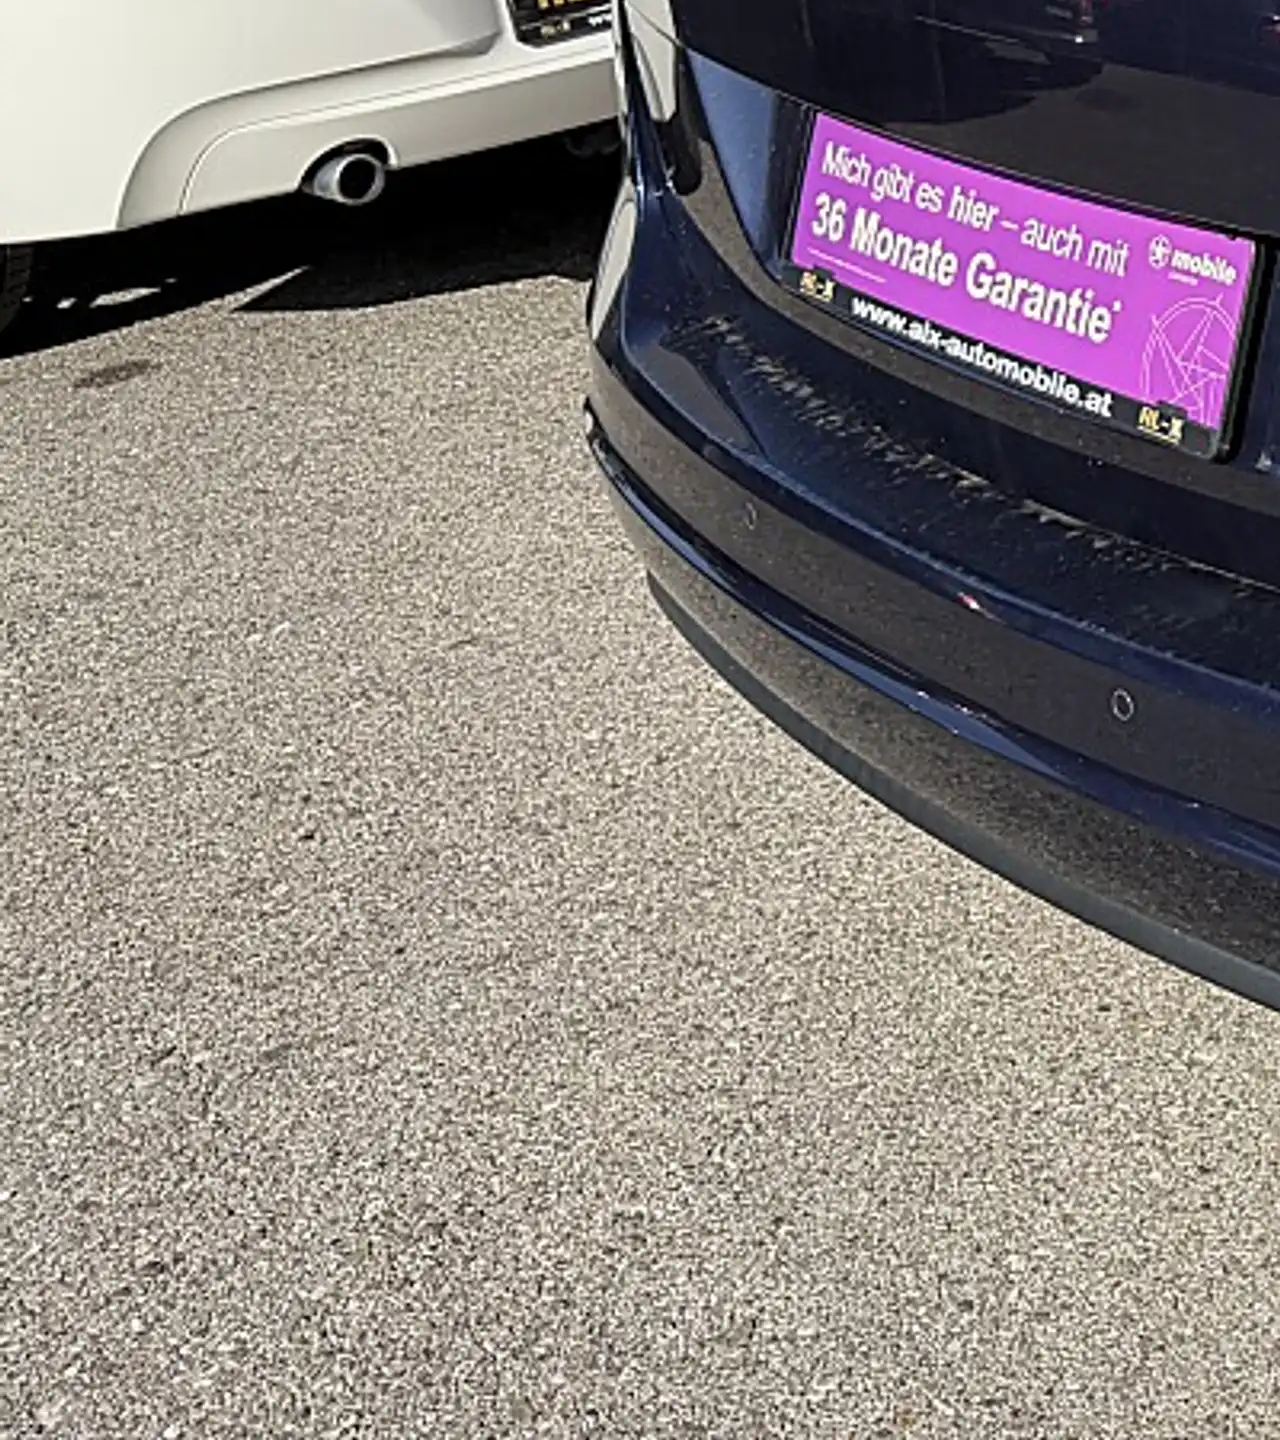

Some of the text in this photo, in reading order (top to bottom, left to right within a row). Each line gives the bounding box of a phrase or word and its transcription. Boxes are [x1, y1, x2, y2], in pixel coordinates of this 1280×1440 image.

[811, 191, 847, 243] 36
[850, 206, 959, 286] Monate
[822, 141, 872, 188] Mich
[869, 162, 917, 203] gibt
[915, 181, 945, 213] es
[946, 185, 1000, 232] hier
[1020, 217, 1084, 262] auch
[1087, 239, 1130, 278] mit
